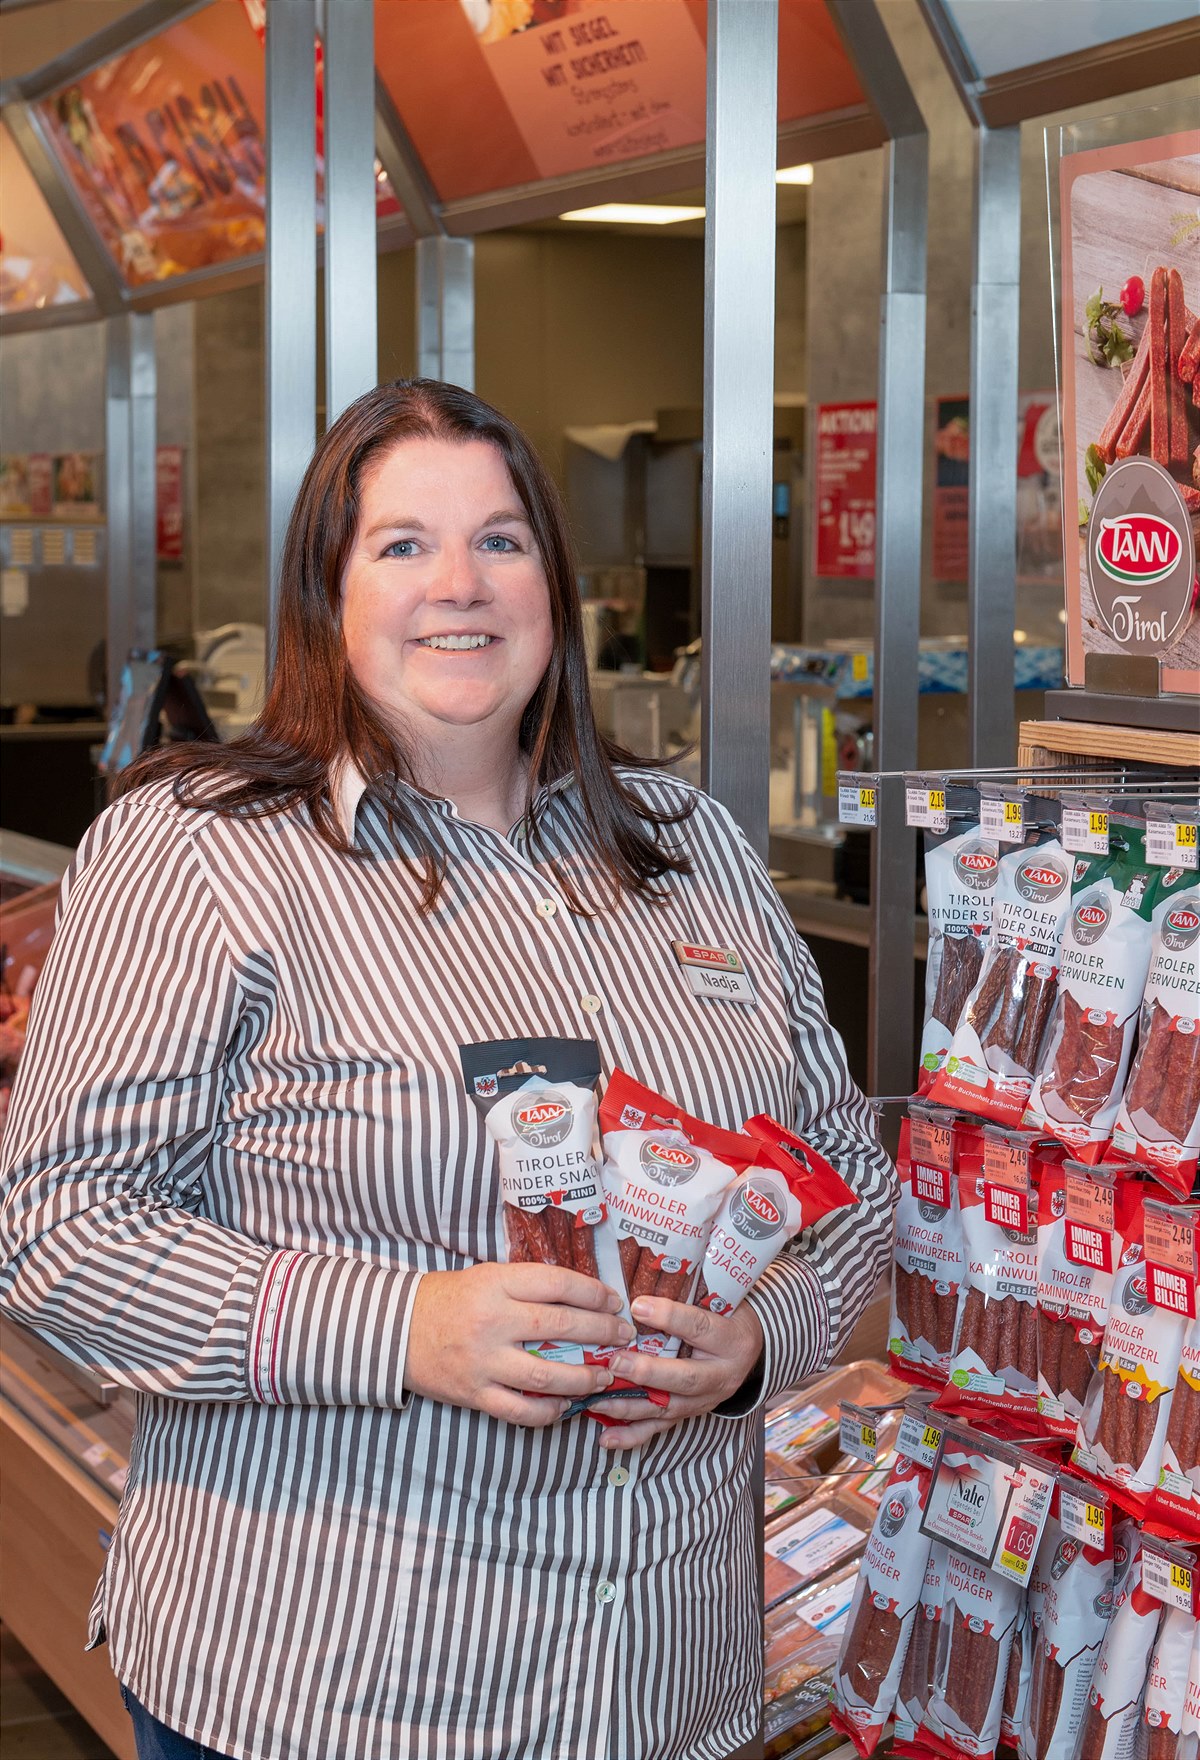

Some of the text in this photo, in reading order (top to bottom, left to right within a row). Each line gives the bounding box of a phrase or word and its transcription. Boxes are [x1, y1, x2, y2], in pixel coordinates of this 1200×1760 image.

[569, 16, 619, 47] SIEGEL
[818, 409, 876, 434] AKTION
[1101, 517, 1170, 563] TANN
[1112, 595, 1168, 643] Tirol
[861, 790, 875, 807] 2,19
[930, 792, 945, 809] 2,19
[1006, 804, 1022, 822] 1,99
[1091, 814, 1108, 832] 1,99
[1177, 825, 1197, 845] 1,99
[961, 854, 994, 869] TANN
[964, 873, 990, 888] Tirol
[1023, 866, 1060, 884] TANN
[1022, 885, 1049, 901] Tirol
[932, 908, 978, 921] RINDER
[1003, 903, 1058, 926] TIROLER
[1079, 906, 1103, 922] TANN
[1171, 910, 1198, 927] TANN
[946, 925, 969, 933] 100%
[1075, 928, 1095, 943] Tirol
[1165, 933, 1187, 949] Tirol
[692, 949, 727, 963] SPAR
[1062, 949, 1104, 969] TIROLER
[700, 972, 741, 993] Nadja
[957, 1084, 989, 1104] Buchenholz
[521, 1105, 560, 1122] TANN
[529, 1129, 561, 1147] Tirol
[934, 1128, 951, 1146] 2,49
[516, 1151, 586, 1173] TIROLER
[650, 1144, 689, 1164] TANN
[1009, 1149, 1027, 1166] 2,49
[503, 1174, 554, 1191] RINDER
[647, 1162, 680, 1185] Tirol
[916, 1164, 943, 1187] IMMER
[520, 1186, 595, 1206] 100% RIND
[625, 1182, 687, 1216] TIROLER
[917, 1180, 944, 1202] BILLIG!
[990, 1188, 1020, 1211] IMMER
[1094, 1186, 1113, 1206] 2,49
[746, 1187, 777, 1220] TANN
[921, 1205, 941, 1219] Tirol
[732, 1209, 760, 1238] Tirol
[991, 1204, 1021, 1227] BILLIG!
[622, 1221, 665, 1244] Classic
[907, 1224, 943, 1245] TIROLER
[1070, 1225, 1102, 1249] IMMER
[1172, 1225, 1192, 1245] 2,49
[909, 1257, 934, 1270] Classic
[1072, 1241, 1104, 1267] BILLIG!
[1176, 1254, 1193, 1266] 20,75
[1051, 1268, 1092, 1290] TIROLER
[1153, 1268, 1187, 1295] IMMER
[1154, 1285, 1189, 1313] BILLIG!
[1069, 1306, 1091, 1320] scharf
[1119, 1357, 1137, 1371] Käse
[977, 1396, 1013, 1410] Buchenholz
[861, 1427, 876, 1445] 1,99
[923, 1427, 941, 1447] 1,99
[953, 1478, 985, 1509] Nahe
[952, 1511, 970, 1525] SPAR
[1086, 1505, 1104, 1527] 1,99
[868, 1534, 896, 1562] TIROLER
[1008, 1525, 1034, 1555] 1.69
[948, 1554, 987, 1583] TIROLER
[1015, 1559, 1028, 1573] 0.30
[1172, 1565, 1191, 1589] 1,99
